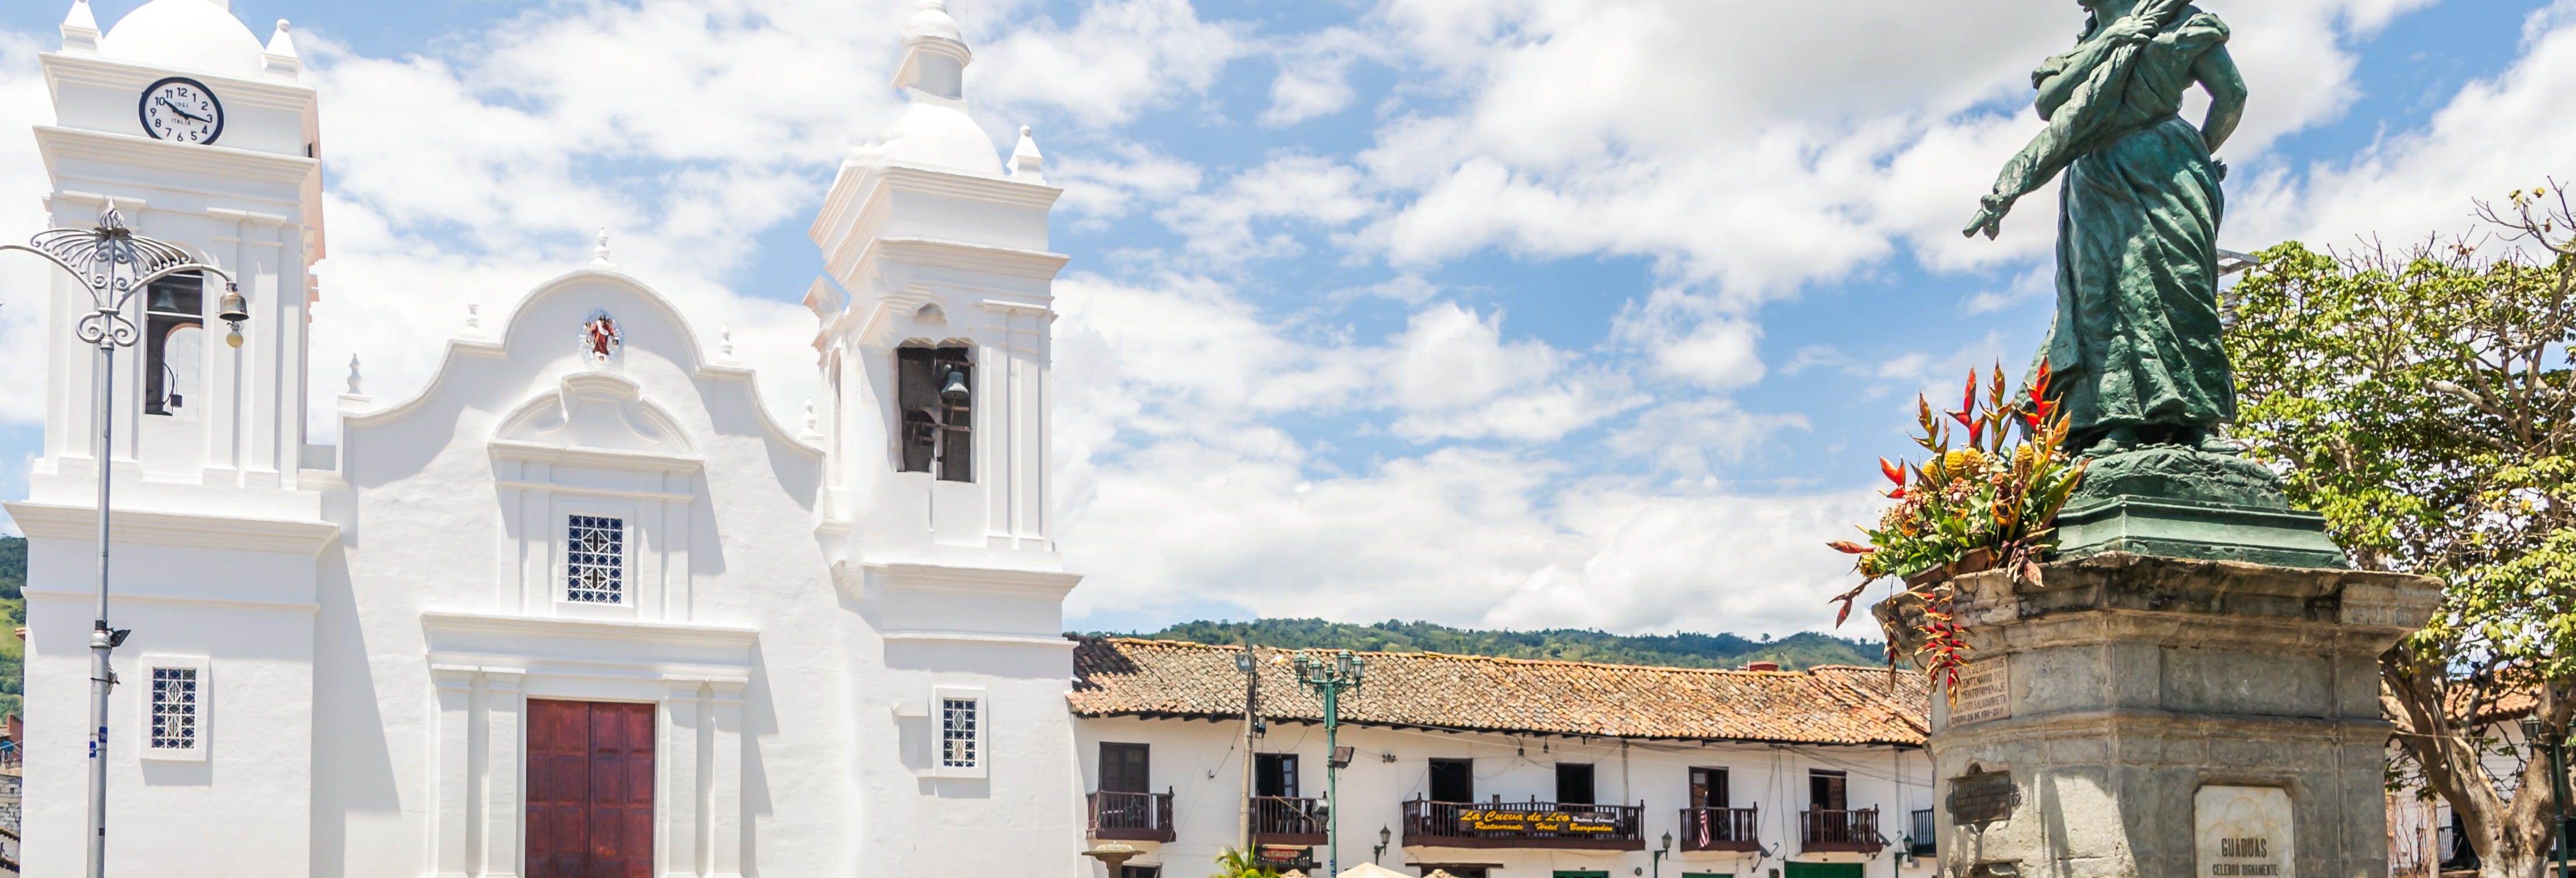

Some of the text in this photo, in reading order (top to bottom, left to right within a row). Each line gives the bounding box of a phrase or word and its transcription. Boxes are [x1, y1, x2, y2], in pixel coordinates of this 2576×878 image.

[165, 89, 173, 100] 11
[177, 87, 188, 98] 12
[155, 96, 166, 107] 10
[192, 93, 196, 103] 1
[201, 101, 209, 111] 2
[150, 107, 157, 117] 9
[155, 118, 162, 128] 8
[171, 118, 191, 126] ITALIA
[206, 114, 213, 124] 3
[165, 127, 172, 138] 7
[201, 125, 208, 135] 4
[177, 132, 184, 142] 6
[191, 131, 198, 141] 5
[1952, 714, 1967, 724] ENERO
[1967, 712, 1974, 722] 26
[1974, 711, 1981, 720] DE
[1461, 810, 1570, 822] La Cueva de Leo
[1474, 821, 1613, 833] Restaurante Hotel Beergarden
[2221, 838, 2267, 858] GUADUAS
[2241, 863, 2278, 876] DIGNAMENTE
